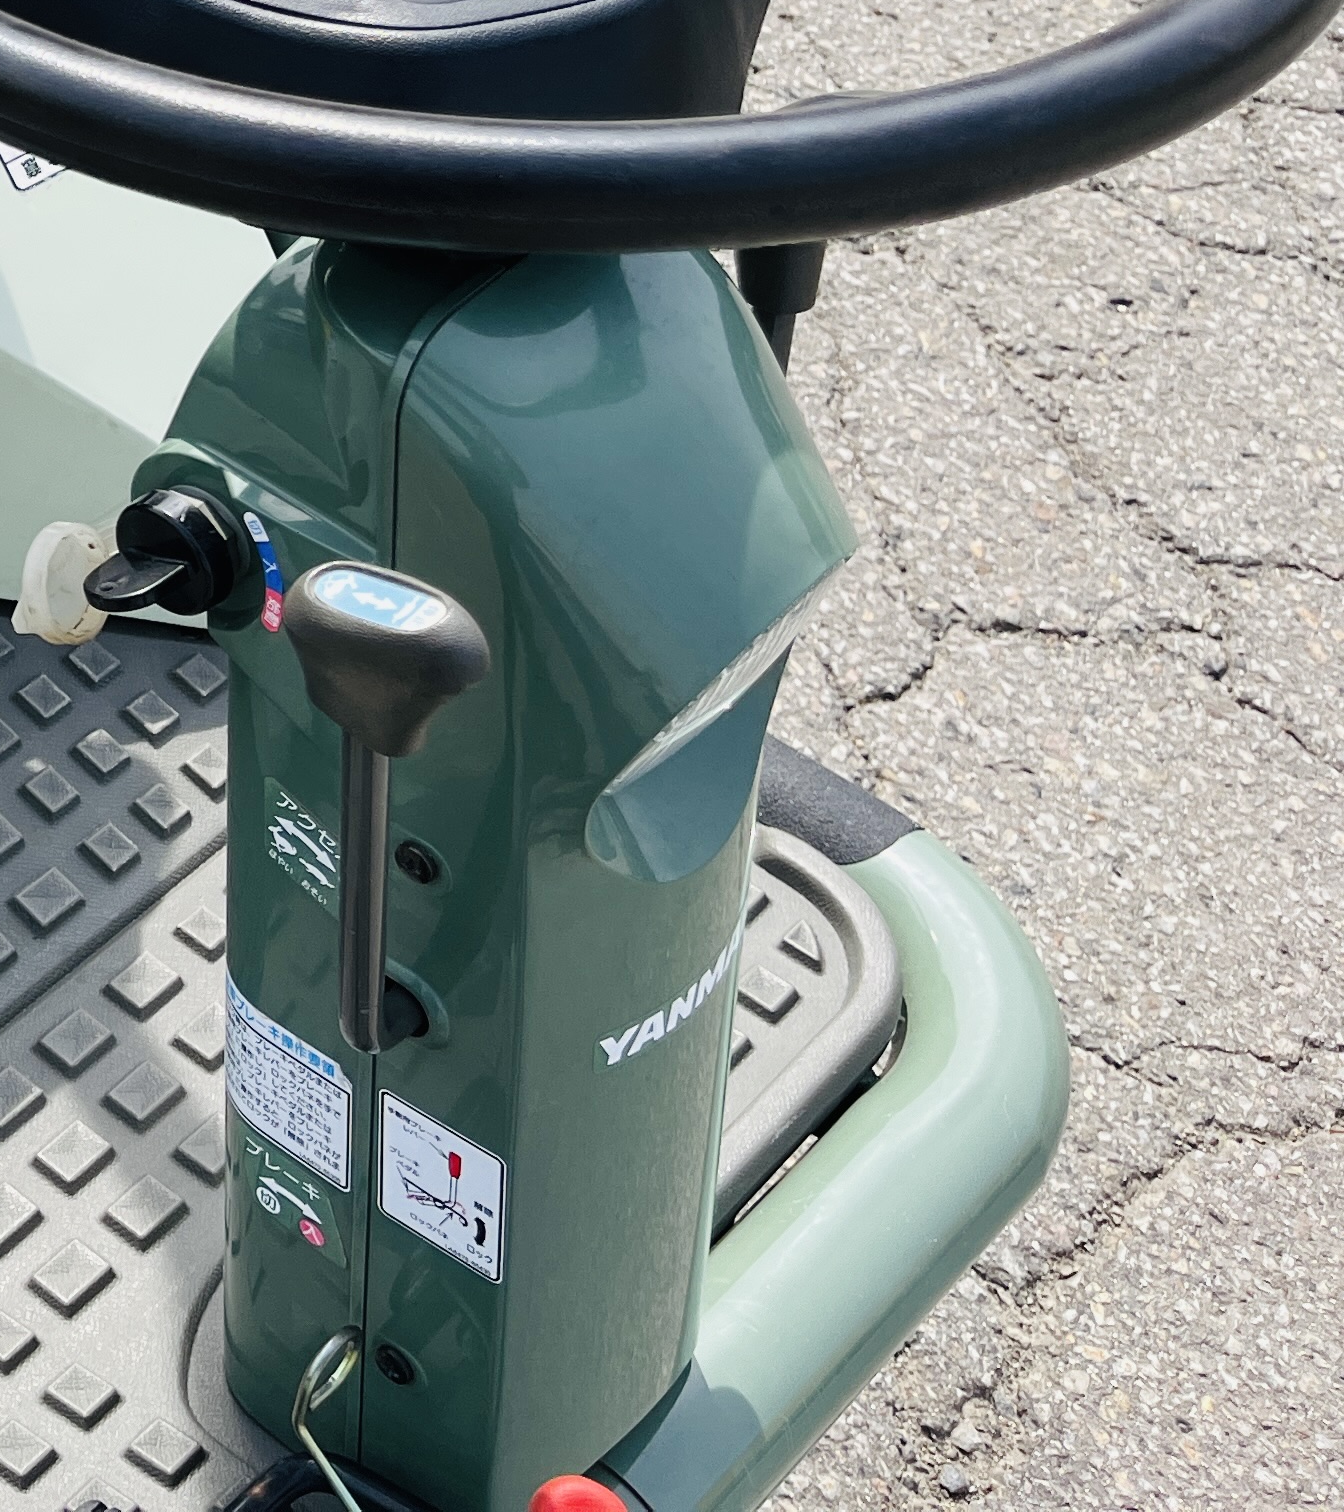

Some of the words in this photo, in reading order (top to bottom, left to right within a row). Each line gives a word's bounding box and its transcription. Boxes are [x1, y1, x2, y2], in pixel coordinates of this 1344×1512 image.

[276, 791, 341, 859] アクセ
[245, 1136, 321, 1201] ブレーキ
